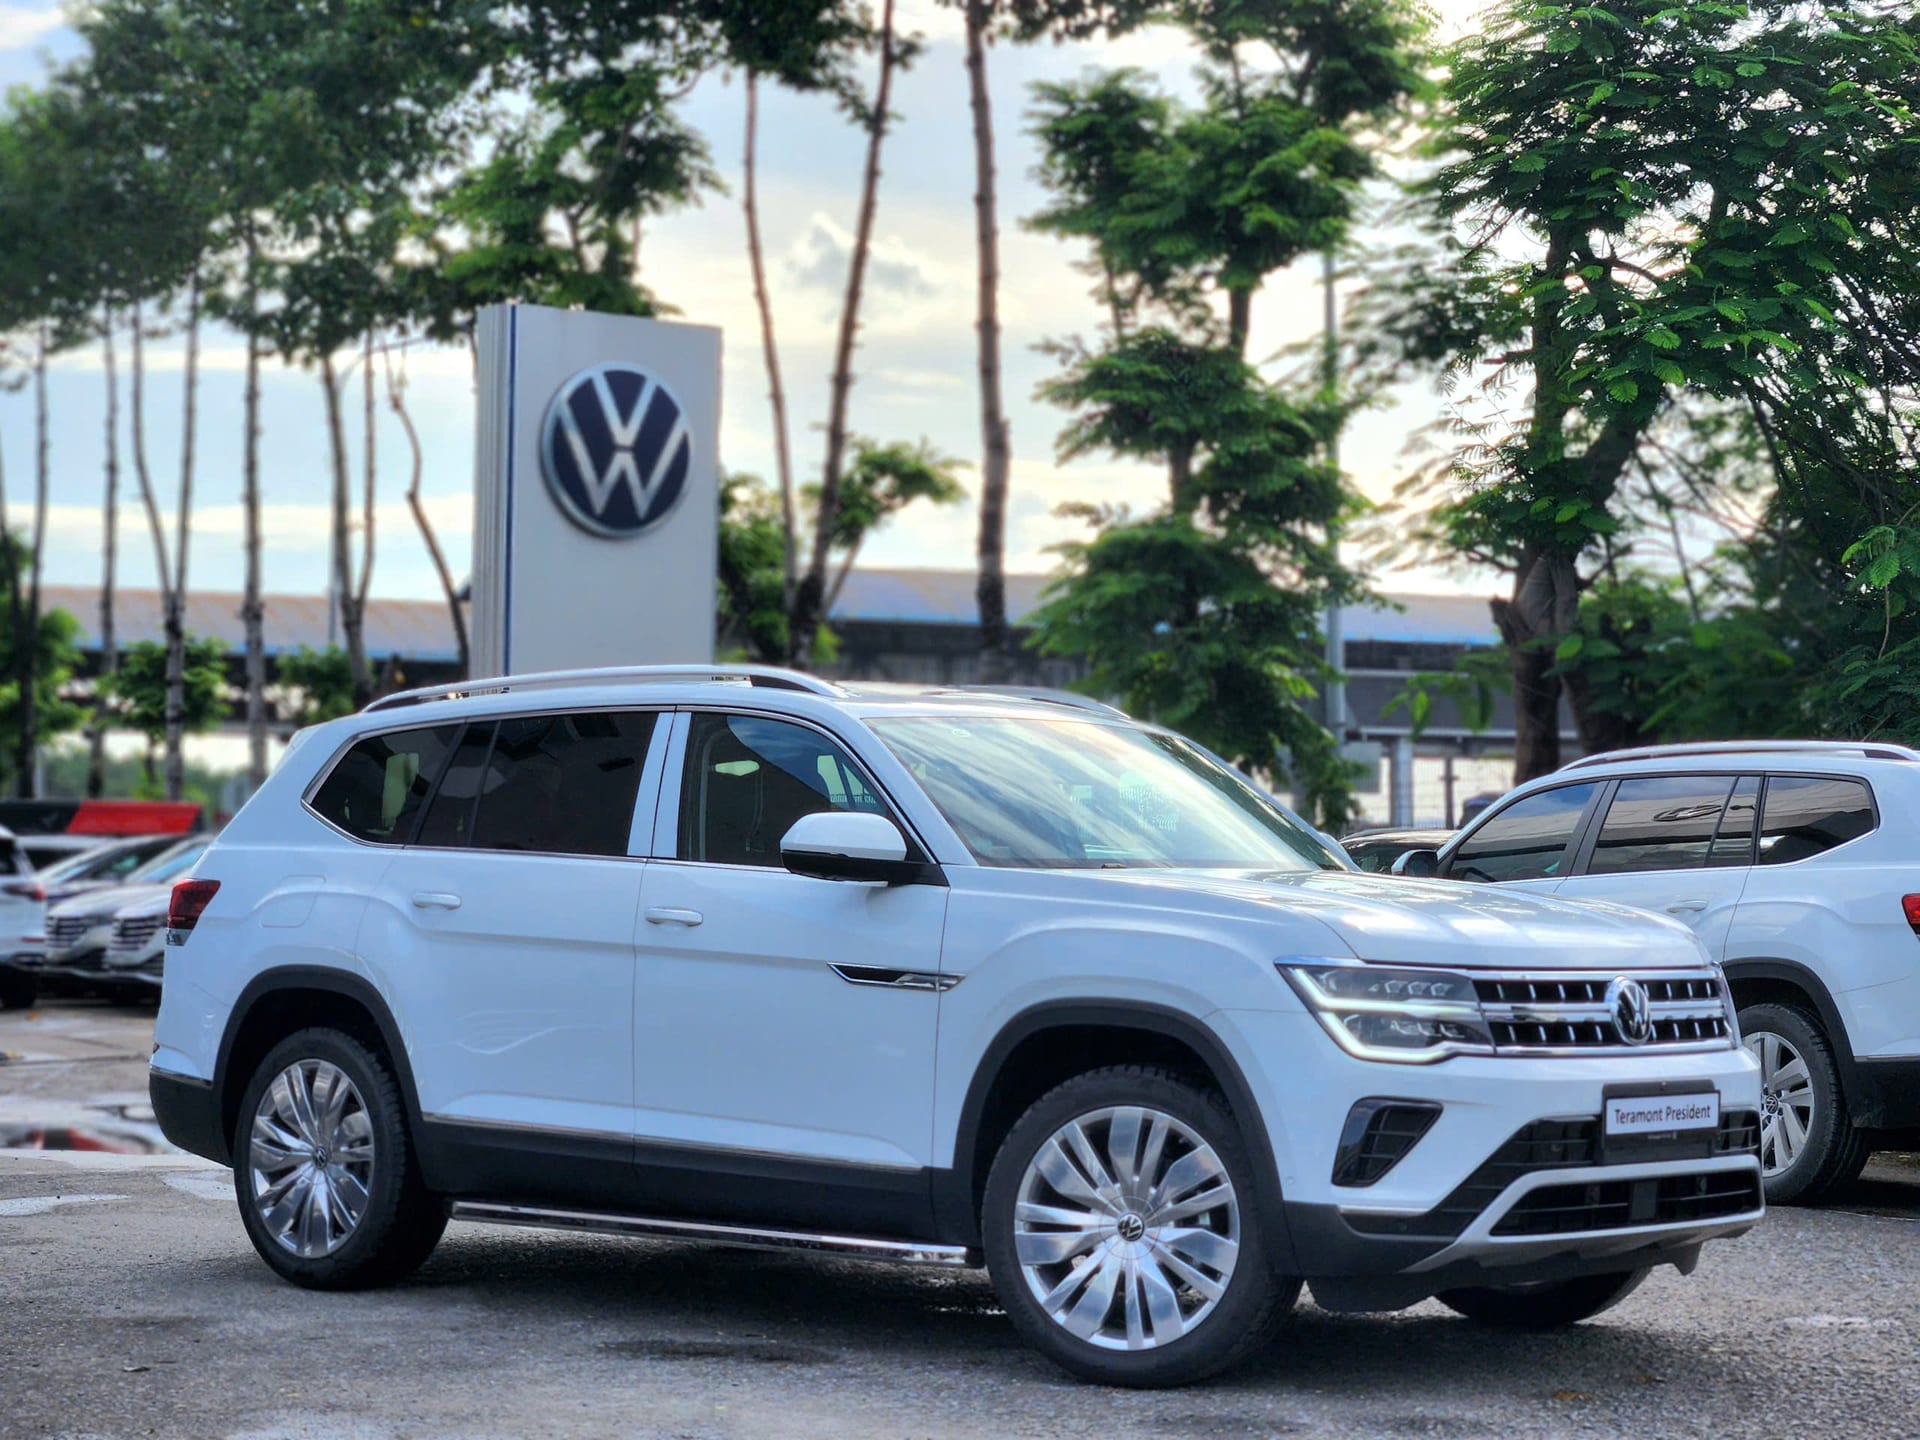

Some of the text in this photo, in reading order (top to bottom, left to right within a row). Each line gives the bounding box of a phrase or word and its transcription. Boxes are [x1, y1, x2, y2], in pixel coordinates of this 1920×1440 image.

[551, 366, 691, 525] VW
[1615, 1103, 1711, 1125] Teramont President
